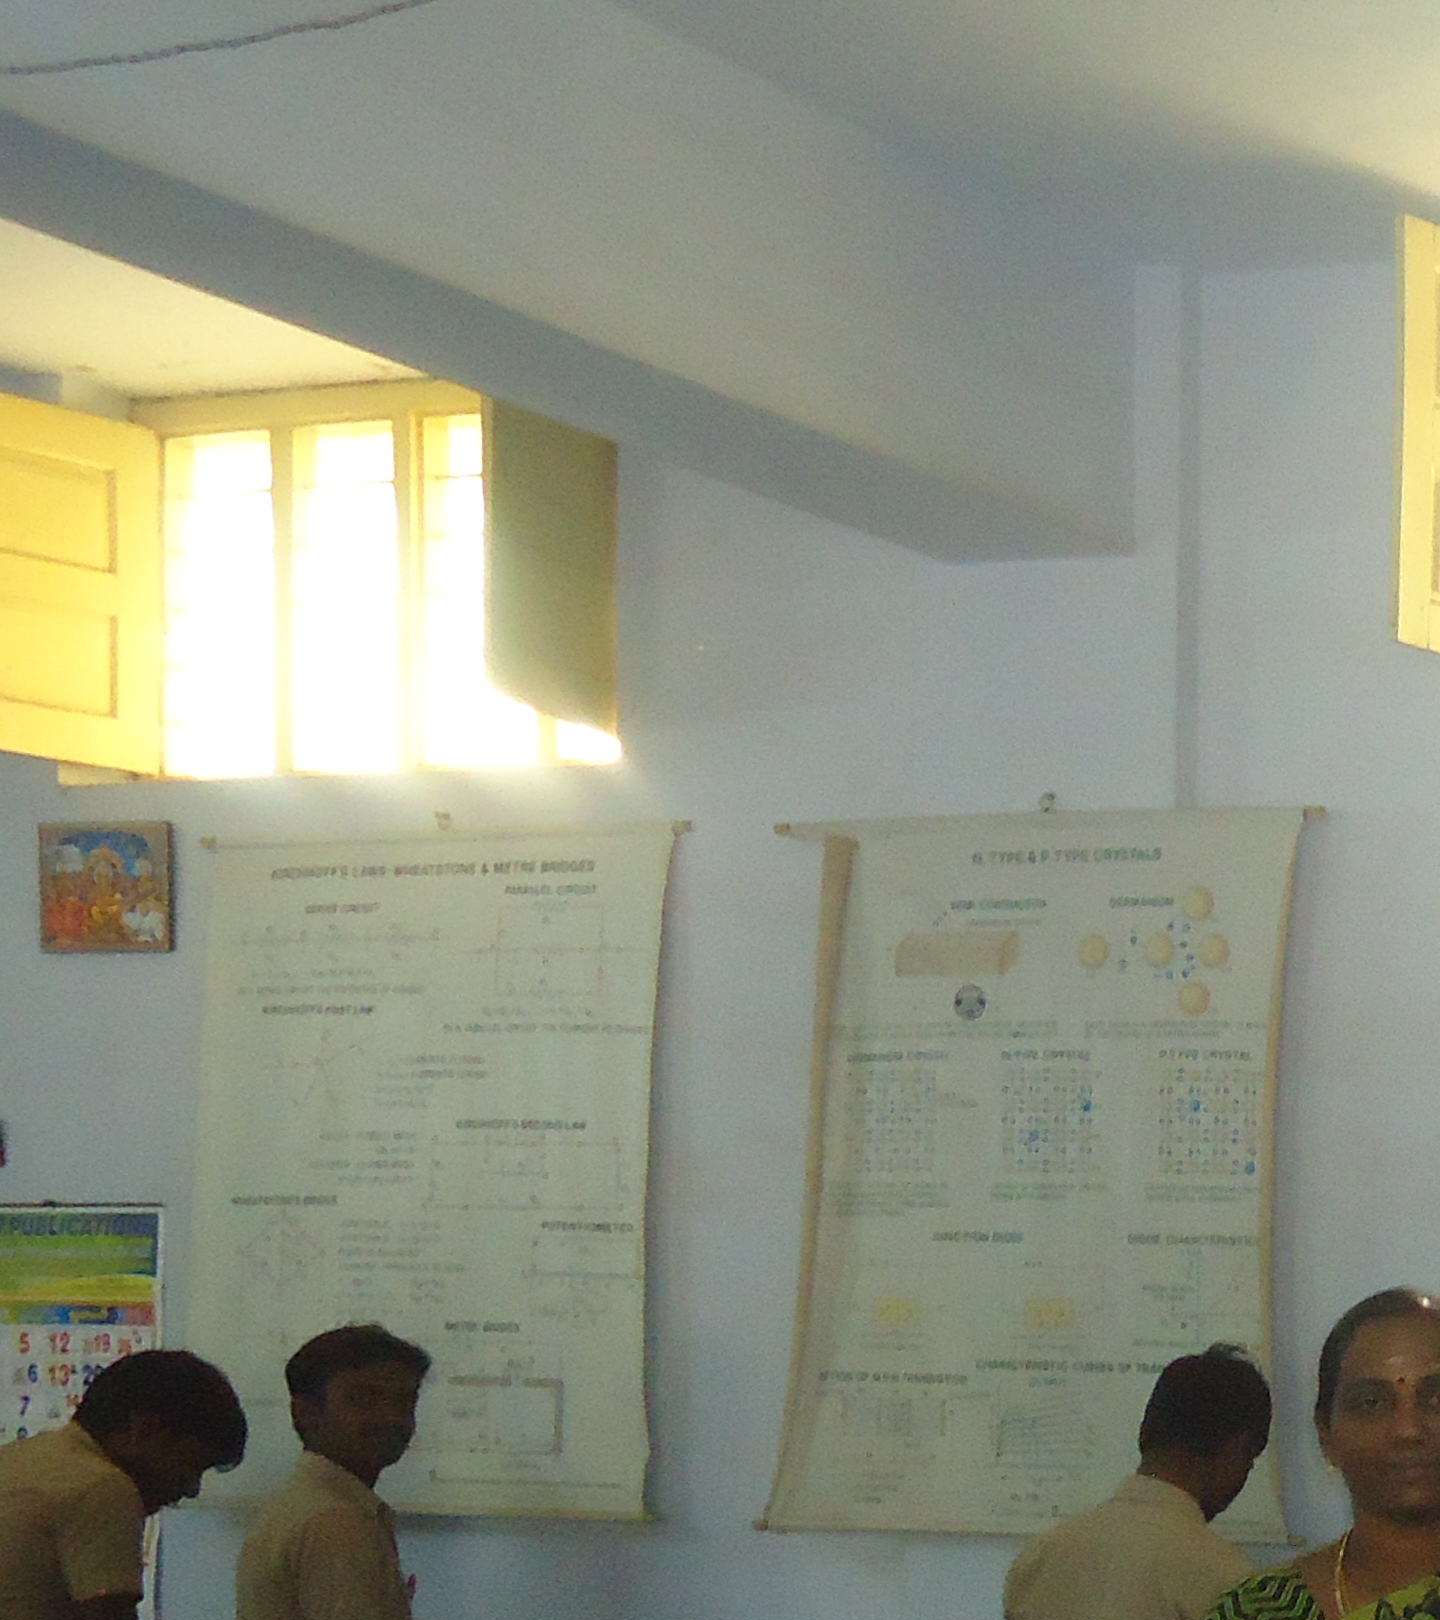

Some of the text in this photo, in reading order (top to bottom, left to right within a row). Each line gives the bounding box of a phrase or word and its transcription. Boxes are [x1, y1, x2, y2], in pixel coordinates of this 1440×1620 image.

[989, 850, 1024, 865] TYPE
[1055, 848, 1089, 863] TYPE
[1093, 847, 1162, 862] CRYSTALS
[18, 1332, 30, 1354] 5
[49, 1332, 71, 1354] 12
[27, 1363, 38, 1383] 6
[48, 1363, 71, 1386] 13
[19, 1395, 31, 1416] 7
